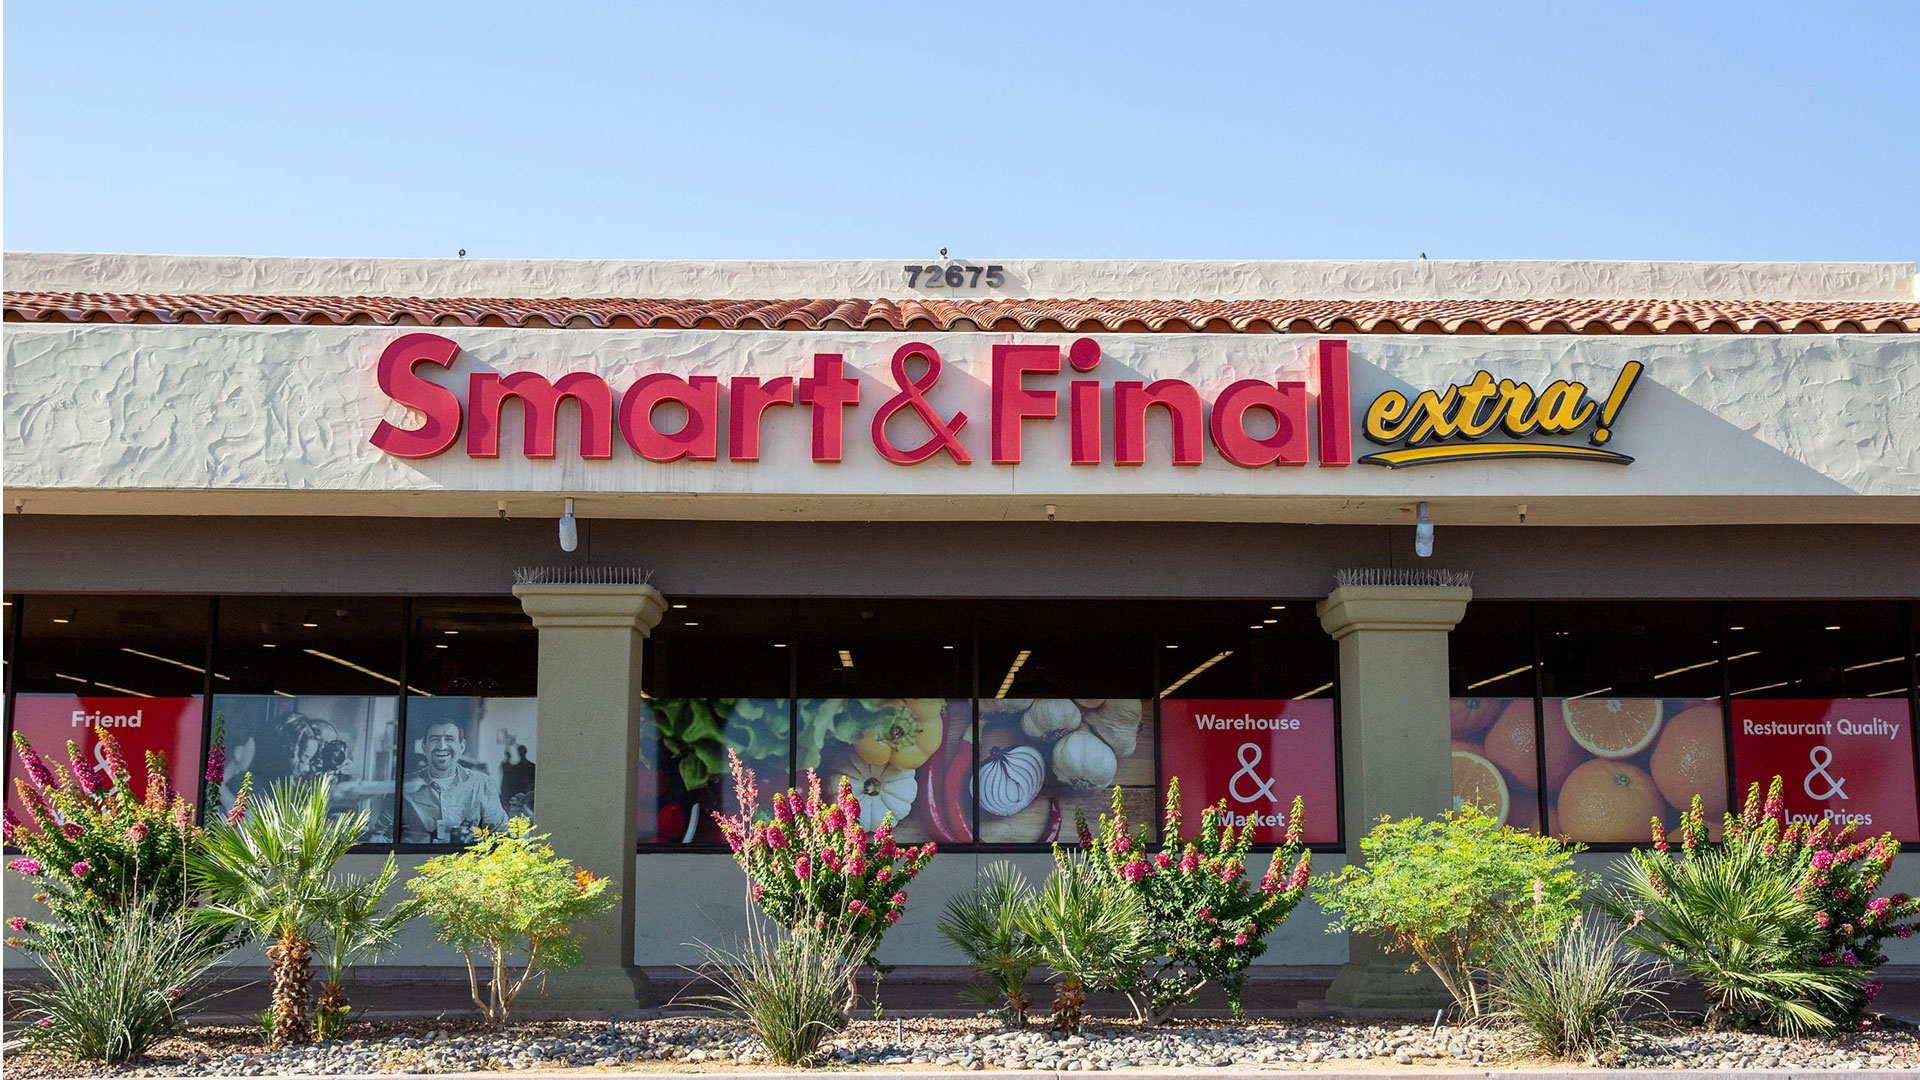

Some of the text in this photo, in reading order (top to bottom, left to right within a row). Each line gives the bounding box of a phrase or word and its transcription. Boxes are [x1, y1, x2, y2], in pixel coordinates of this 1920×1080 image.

[904, 265, 1004, 288] 72675
[369, 332, 1645, 468] Smart & Final extra!
[71, 710, 142, 728] Friend
[1195, 713, 1301, 730] Warehouse
[1743, 717, 1900, 740] Restaurant Quality
[1229, 742, 1278, 803] &
[1803, 746, 1849, 800] &
[1784, 809, 1873, 825] Low Prices
